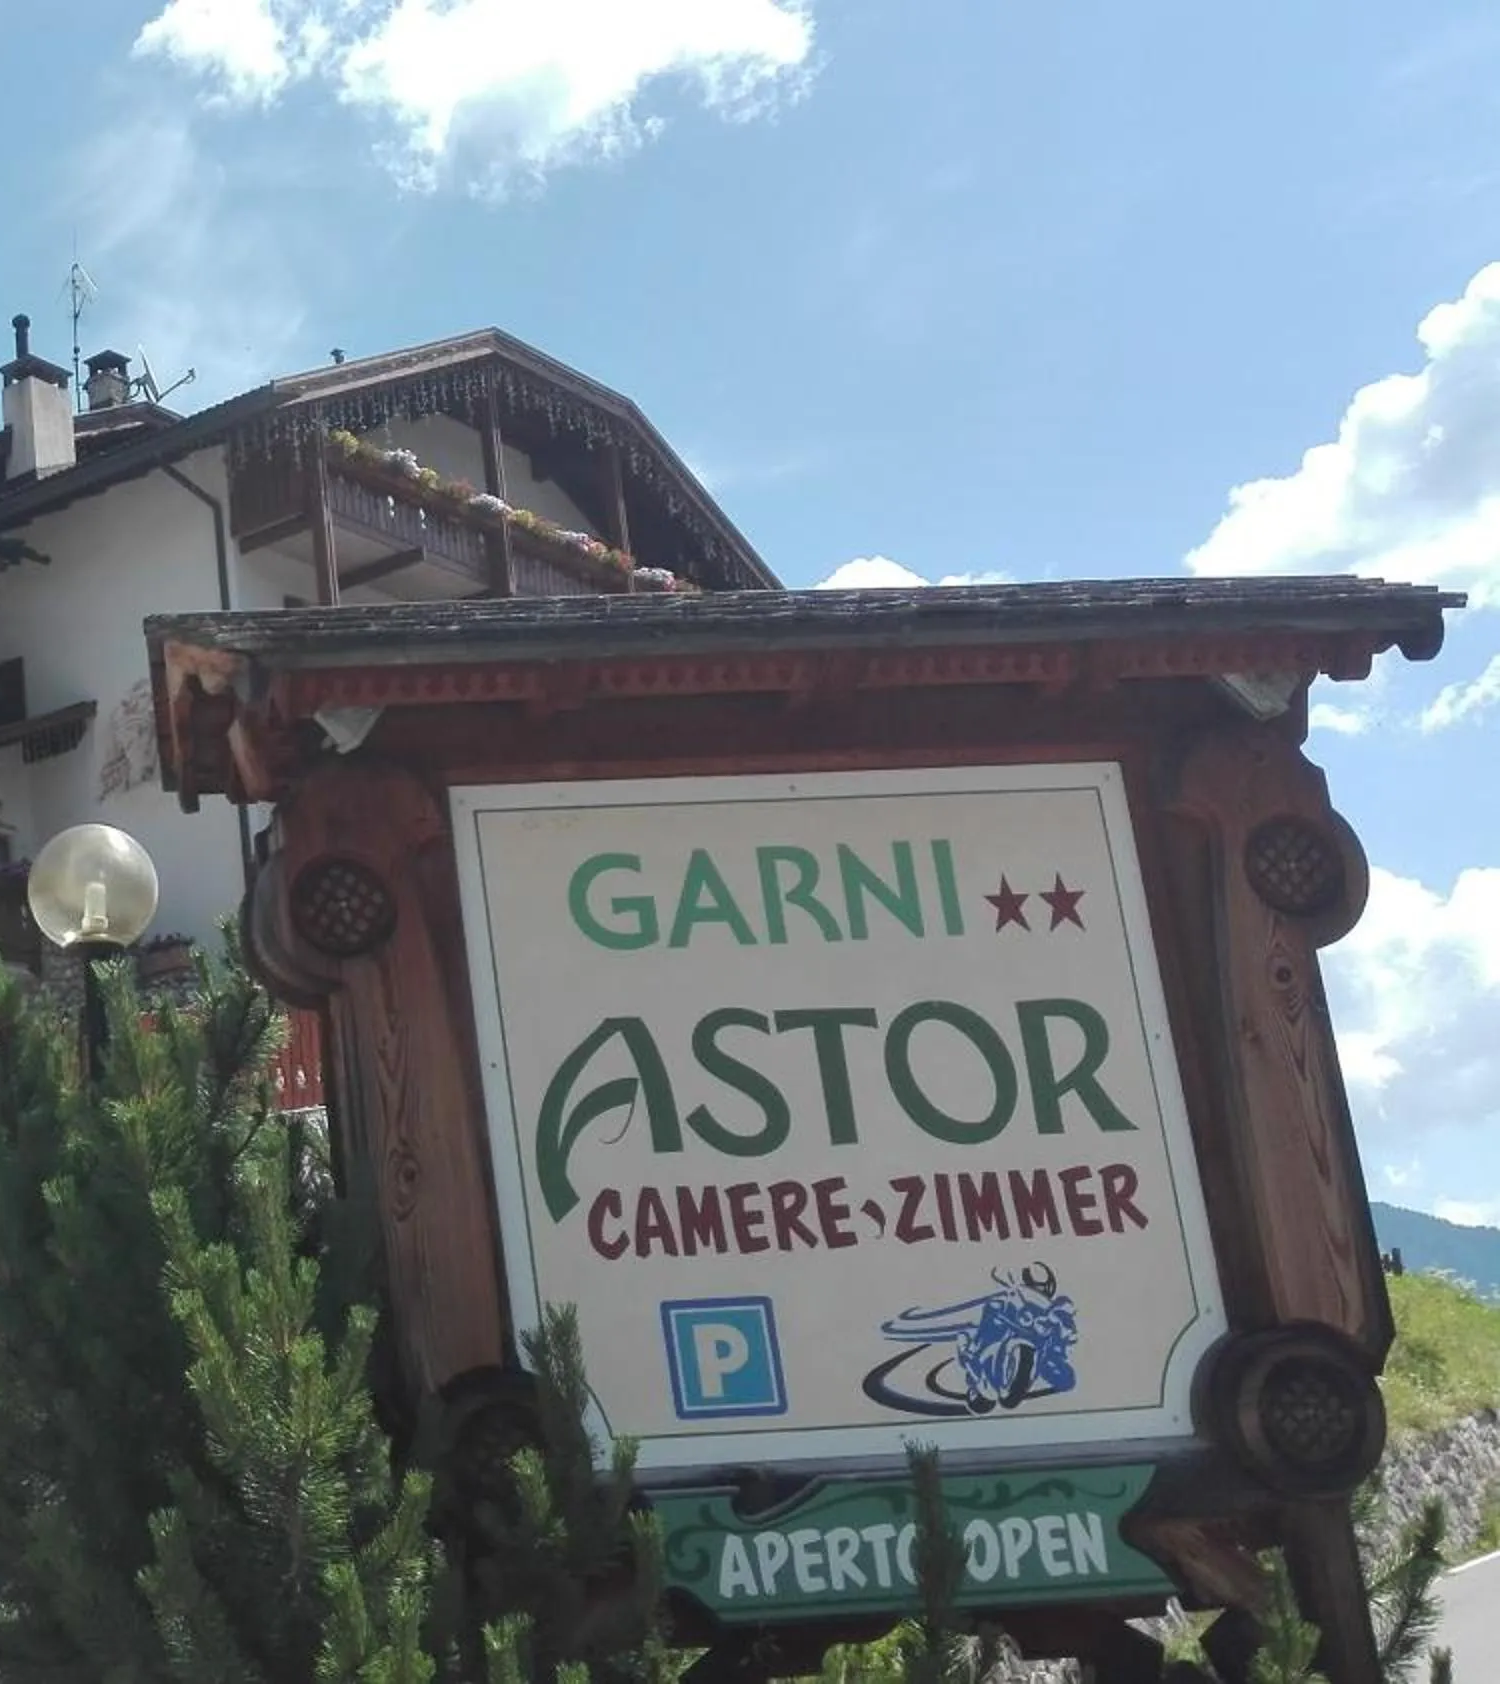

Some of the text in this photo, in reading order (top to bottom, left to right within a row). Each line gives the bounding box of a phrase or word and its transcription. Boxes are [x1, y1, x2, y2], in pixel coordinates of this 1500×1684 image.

[568, 839, 966, 950] GARNI
[535, 998, 1139, 1223] ASTOR
[889, 1163, 1149, 1245] ZIMMER
[692, 1323, 749, 1398] P
[963, 1512, 1109, 1583] OPEN
